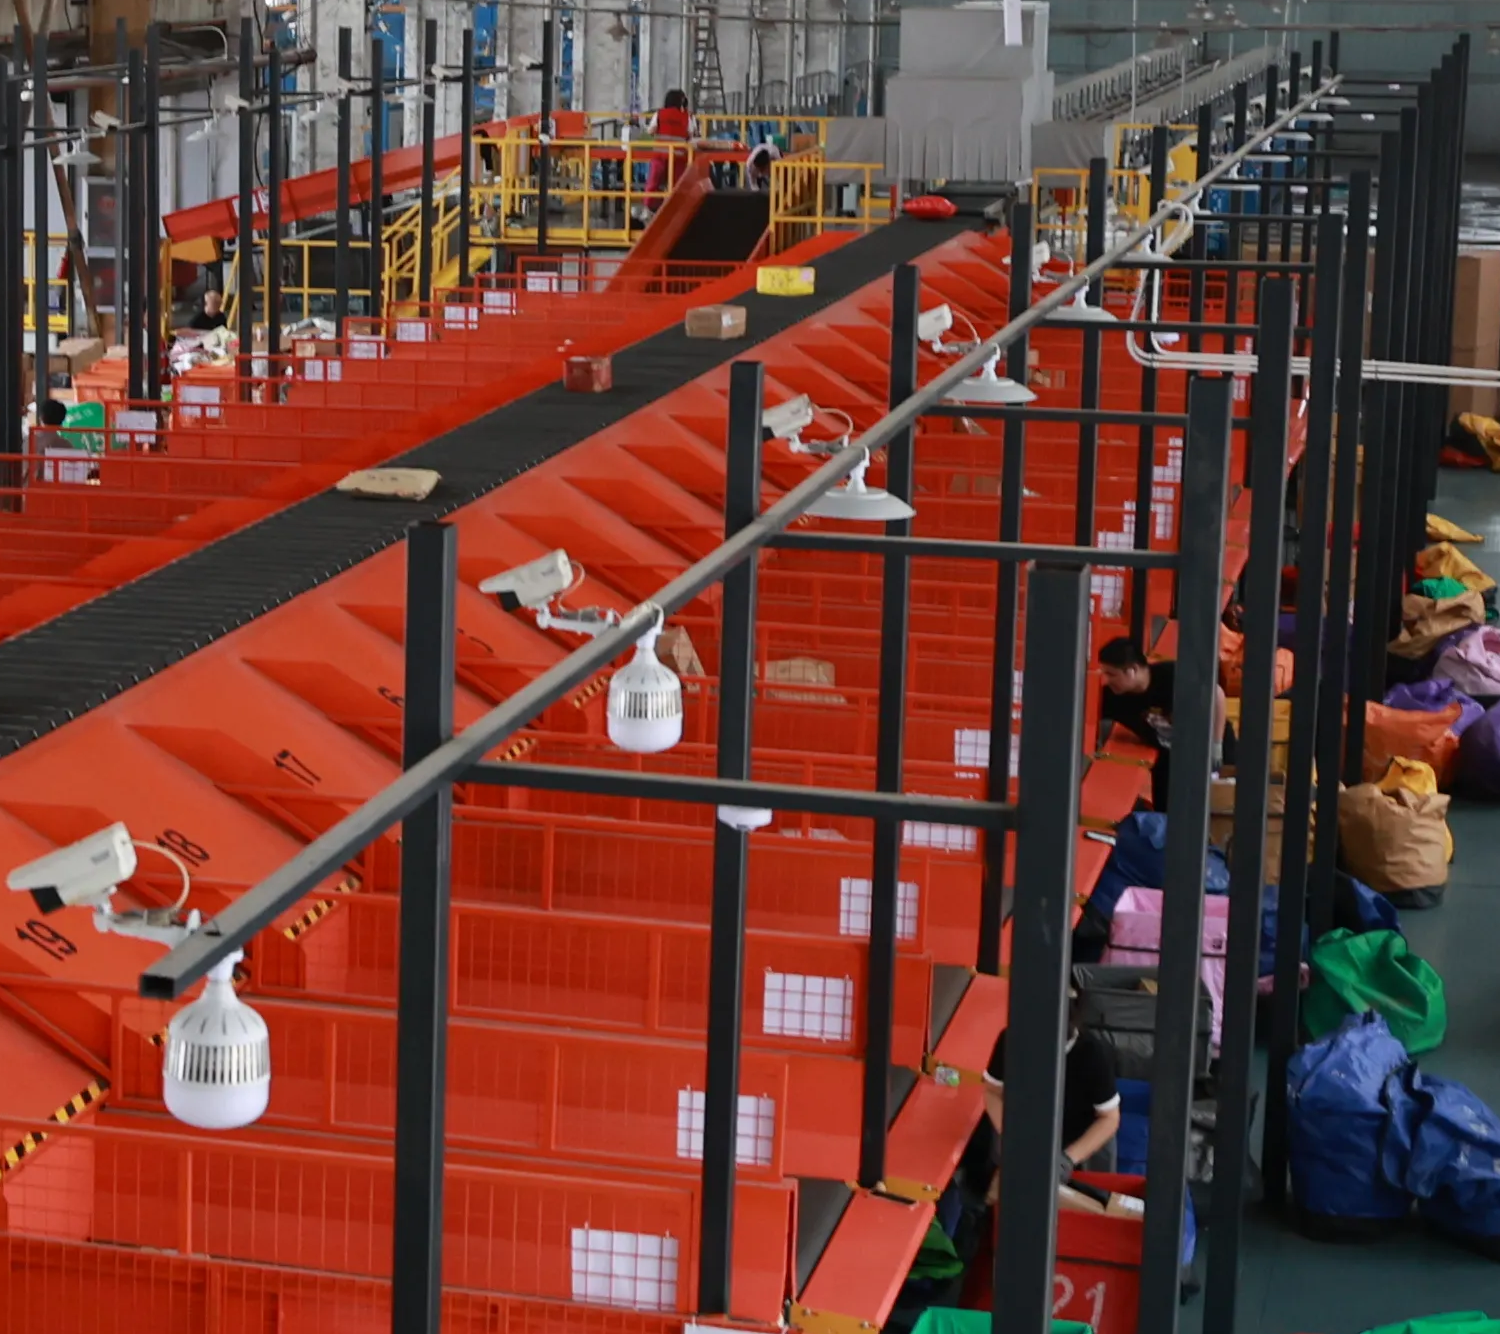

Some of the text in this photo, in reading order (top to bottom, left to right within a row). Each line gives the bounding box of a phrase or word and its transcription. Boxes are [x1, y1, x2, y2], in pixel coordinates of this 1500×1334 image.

[273, 749, 322, 786] 17
[155, 827, 210, 867] 18
[15, 918, 78, 961] 19
